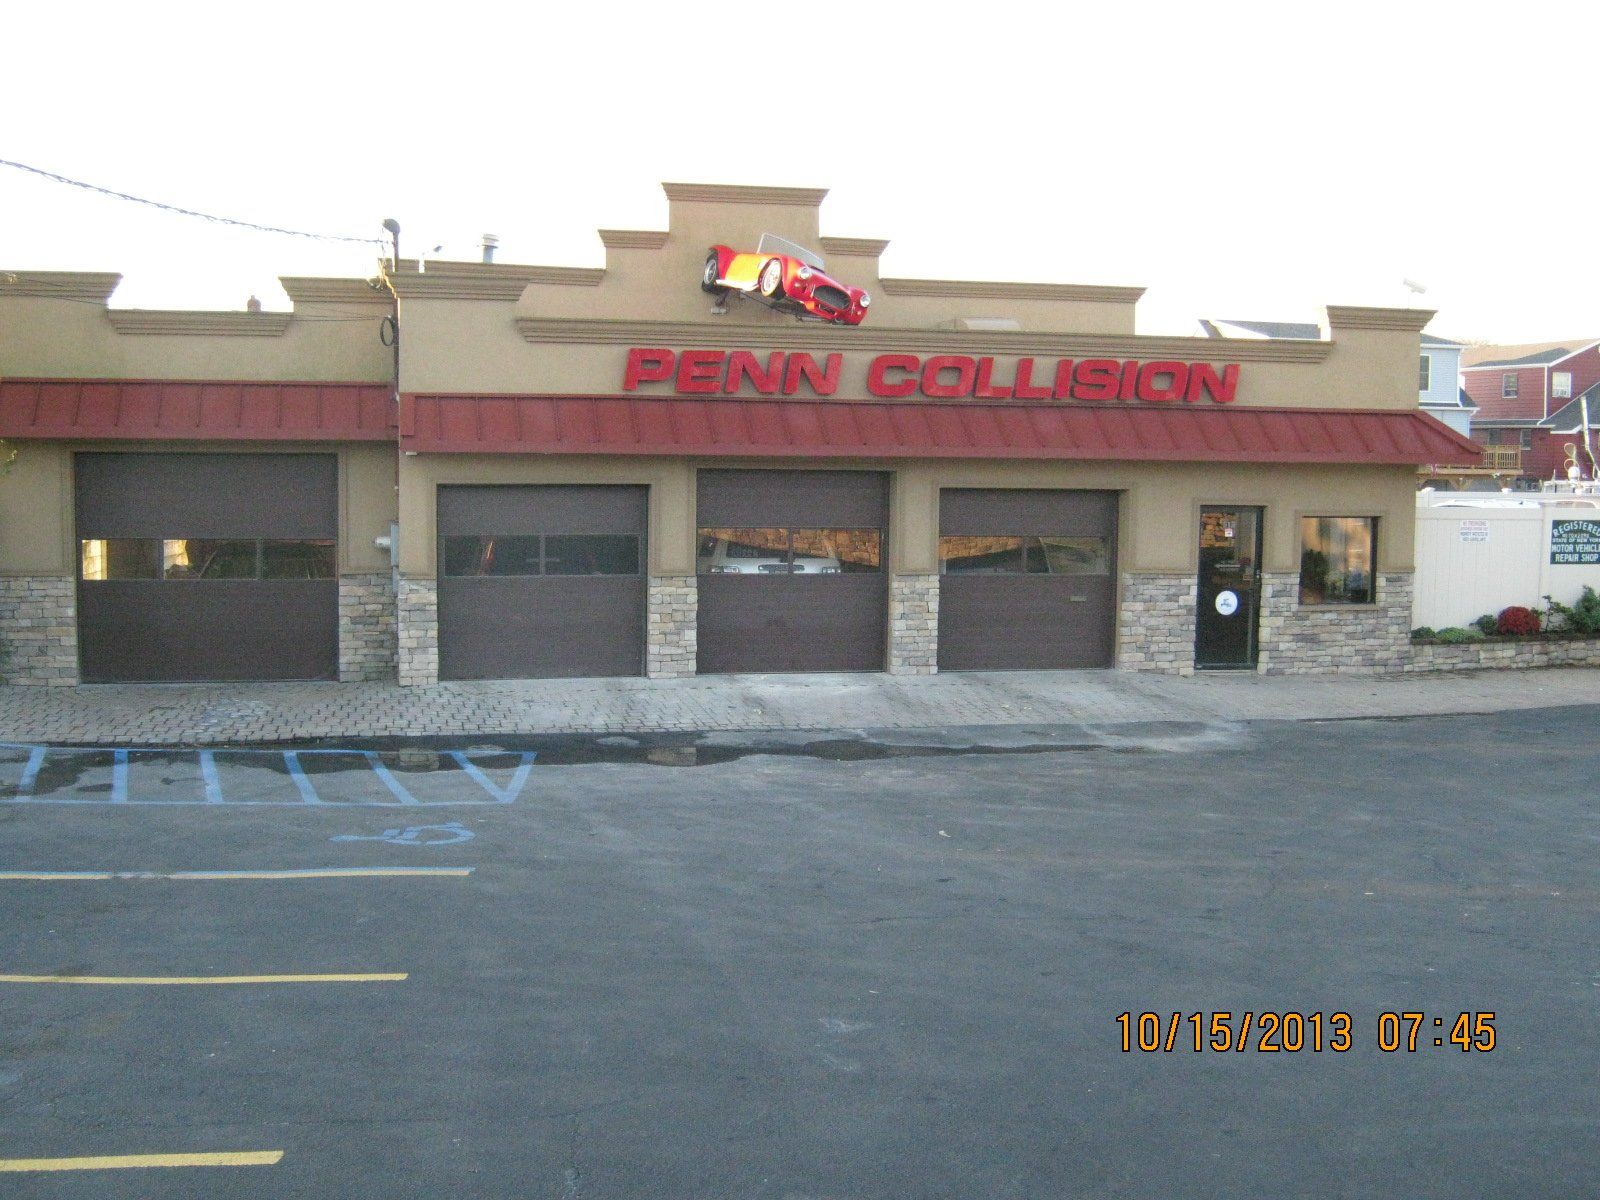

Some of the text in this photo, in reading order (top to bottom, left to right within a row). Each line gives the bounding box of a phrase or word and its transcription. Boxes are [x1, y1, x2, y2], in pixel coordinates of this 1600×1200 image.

[623, 348, 1241, 403] PENN COLLISION
[1551, 544, 1574, 552] MOTOR
[1555, 553, 1599, 562] REPAIR SHOP
